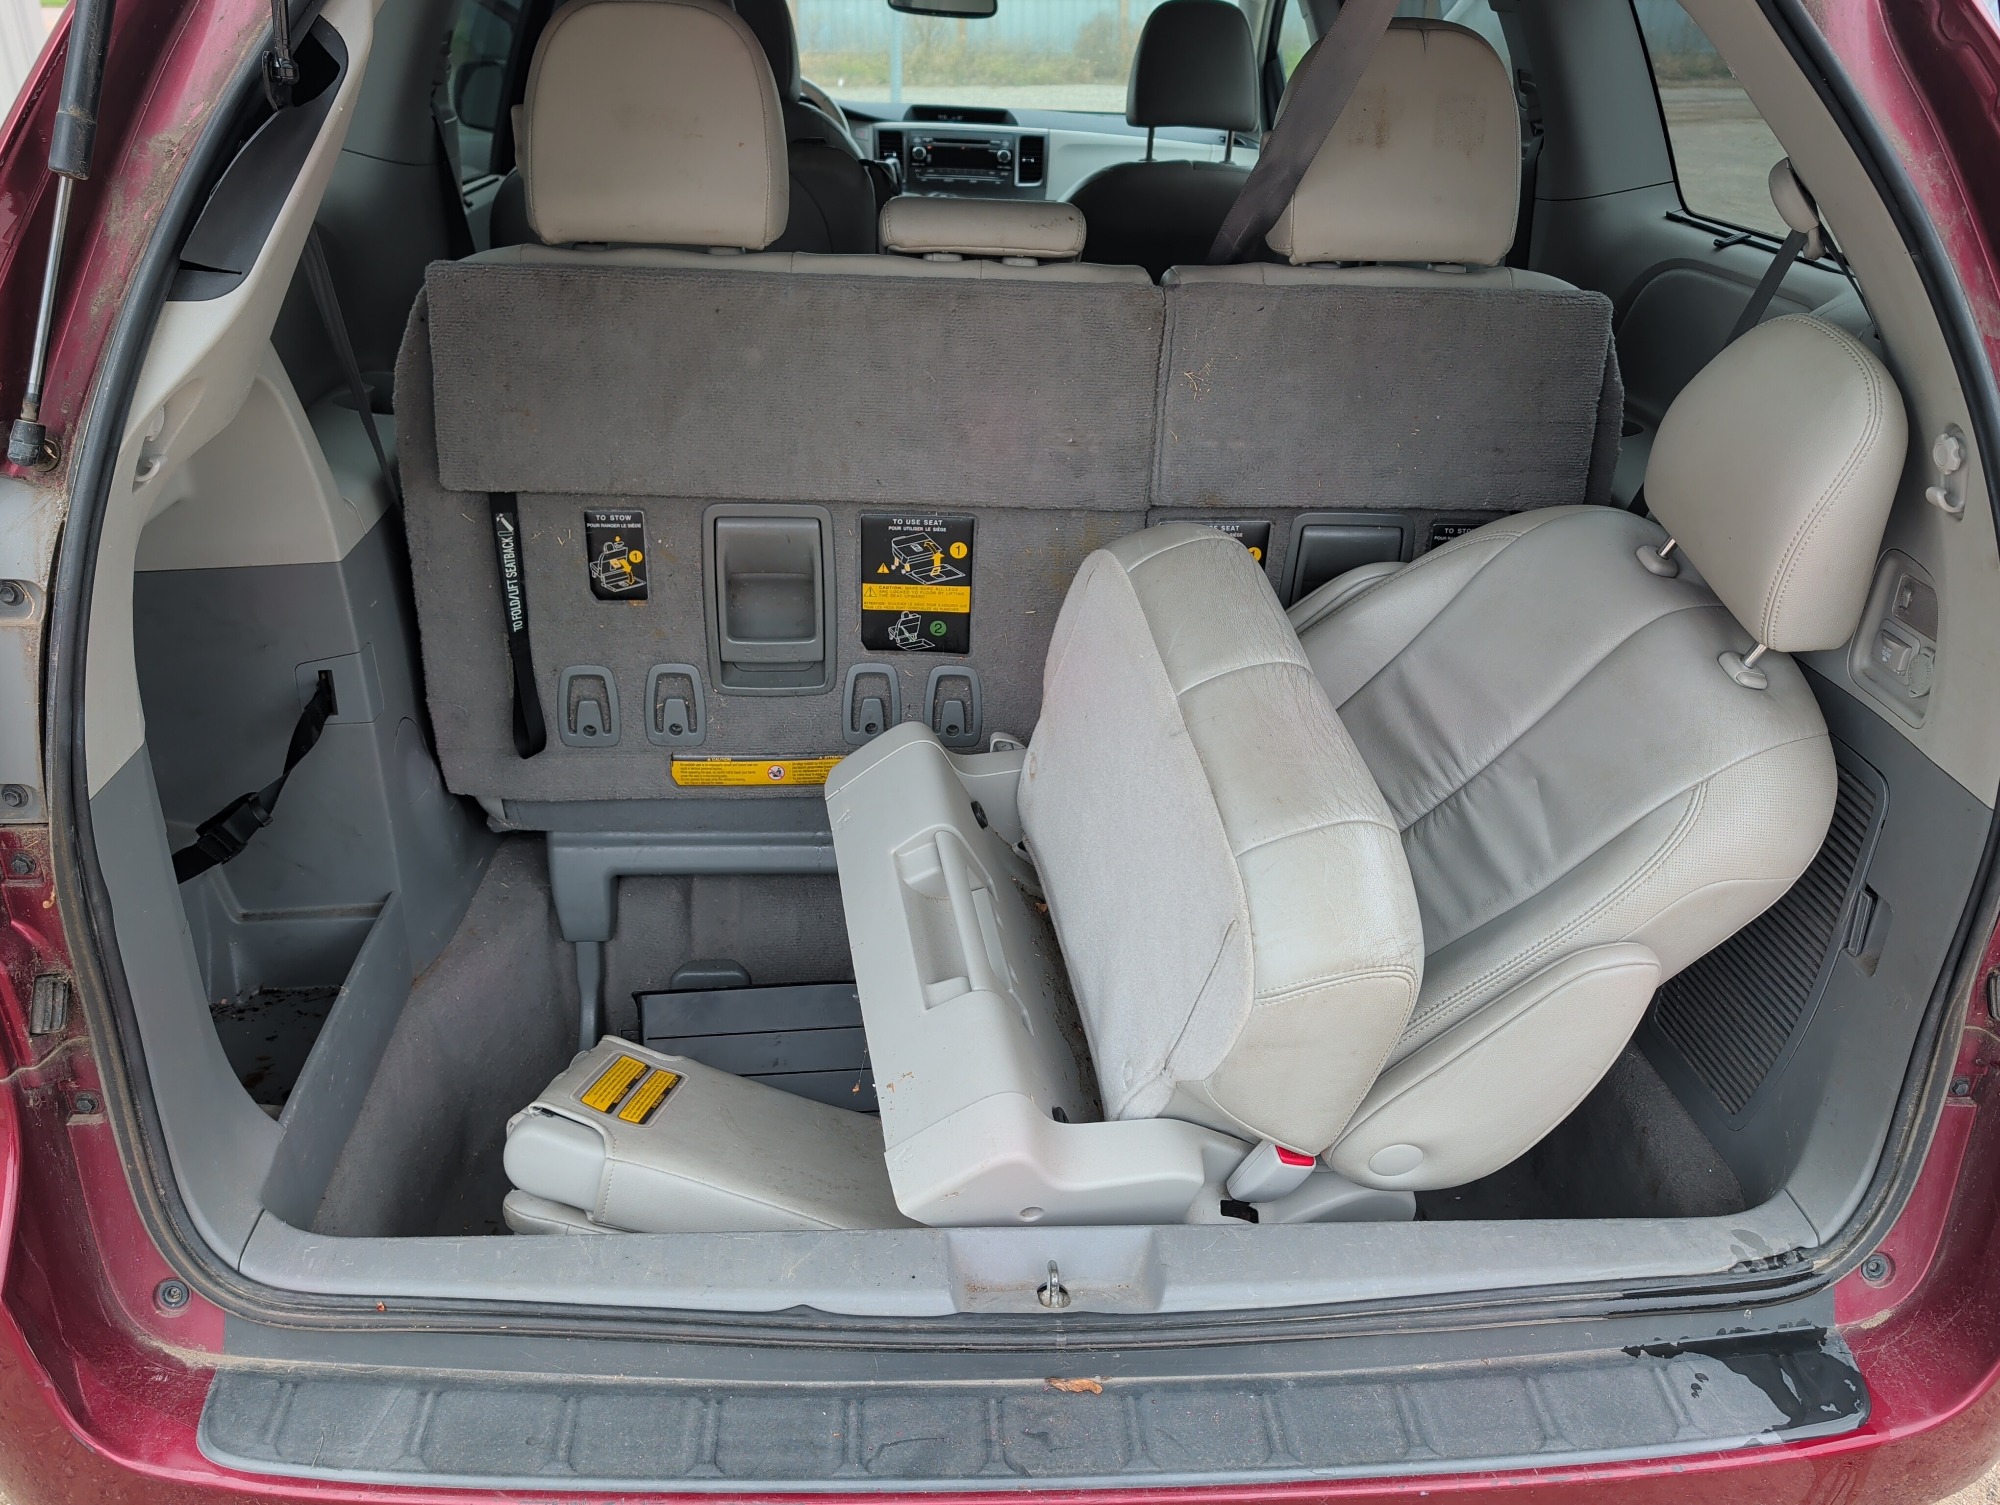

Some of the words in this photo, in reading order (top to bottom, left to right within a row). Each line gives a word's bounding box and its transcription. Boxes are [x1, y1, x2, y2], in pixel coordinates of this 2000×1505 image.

[955, 545, 961, 556] 1
[501, 536, 518, 578] SEATBACK
[633, 553, 638, 561] 1
[506, 579, 522, 620] FOLD/LIFT
[513, 620, 523, 633] TO
[933, 622, 942, 634] 2
